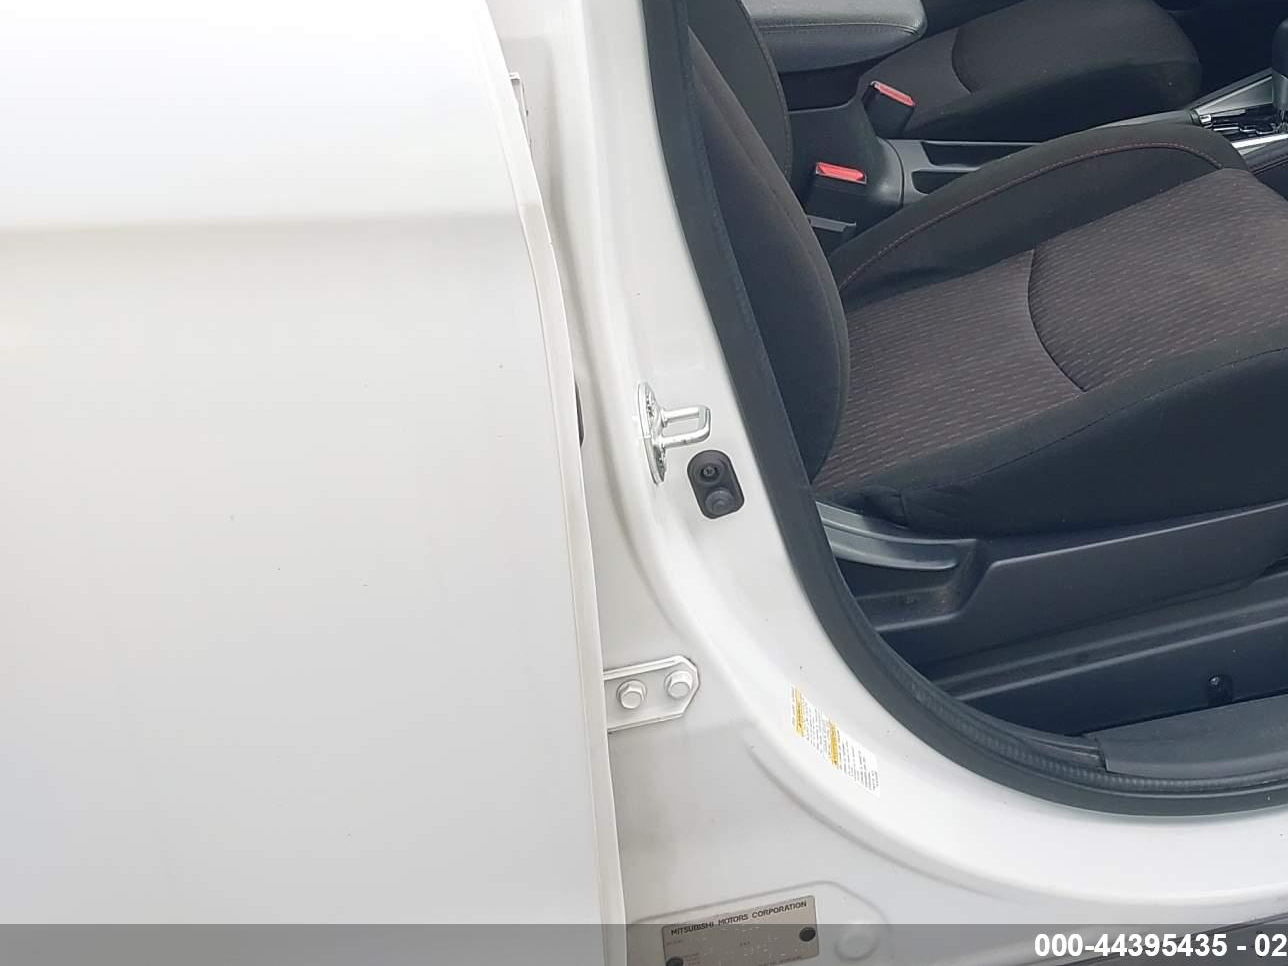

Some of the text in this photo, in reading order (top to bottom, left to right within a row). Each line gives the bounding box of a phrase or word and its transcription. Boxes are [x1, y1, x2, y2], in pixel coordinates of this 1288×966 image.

[670, 900, 807, 936] MITSUBISHI MOTORS CORPORATION
